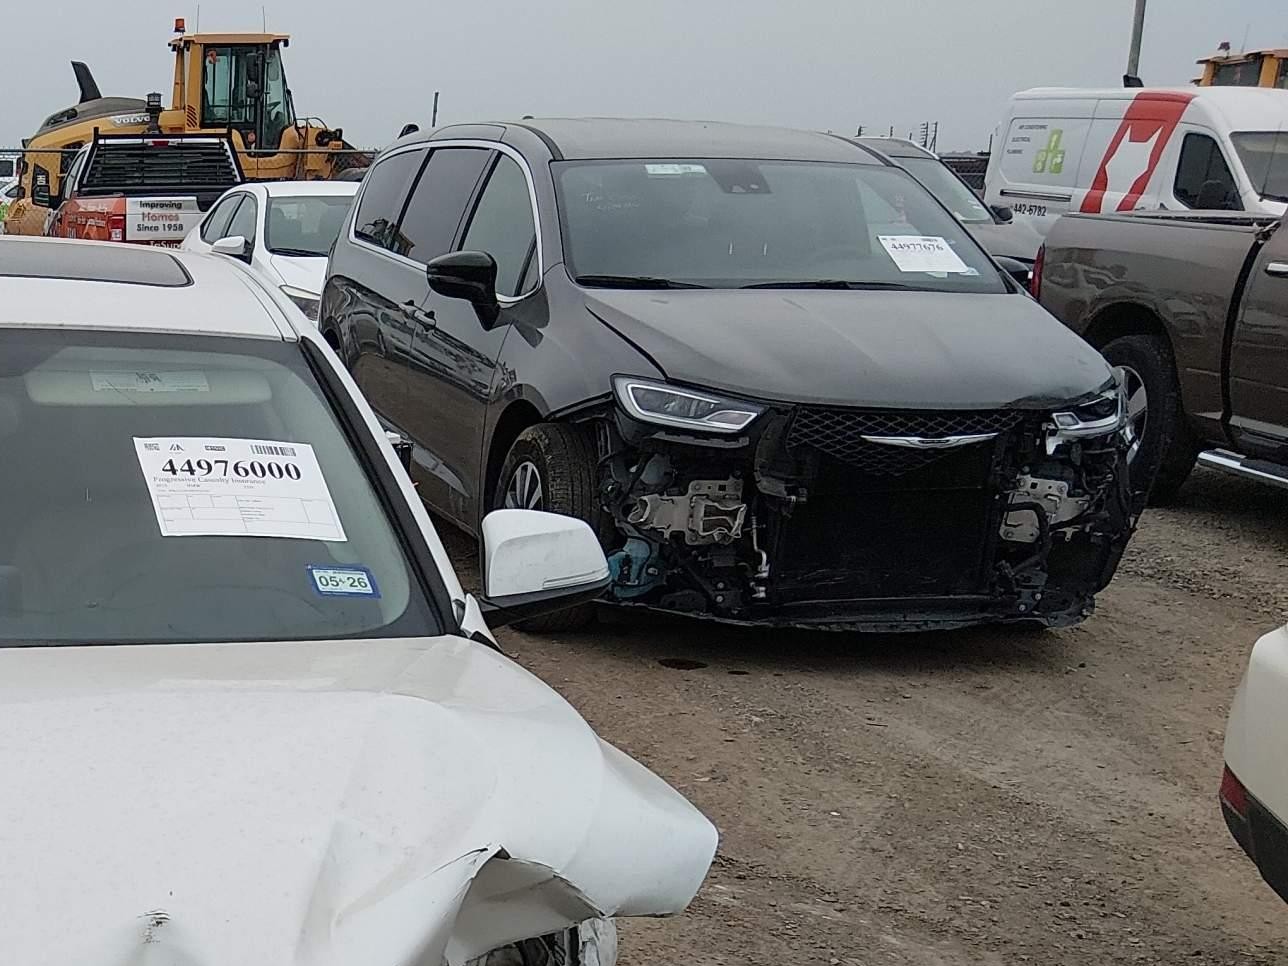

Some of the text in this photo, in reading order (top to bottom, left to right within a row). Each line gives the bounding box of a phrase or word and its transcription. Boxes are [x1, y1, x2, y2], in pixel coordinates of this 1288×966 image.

[139, 200, 183, 210] Improving
[142, 212, 180, 222] Homes
[137, 223, 184, 232] Since 1958
[162, 458, 302, 481] 44976000
[318, 575, 368, 589] 05 26
